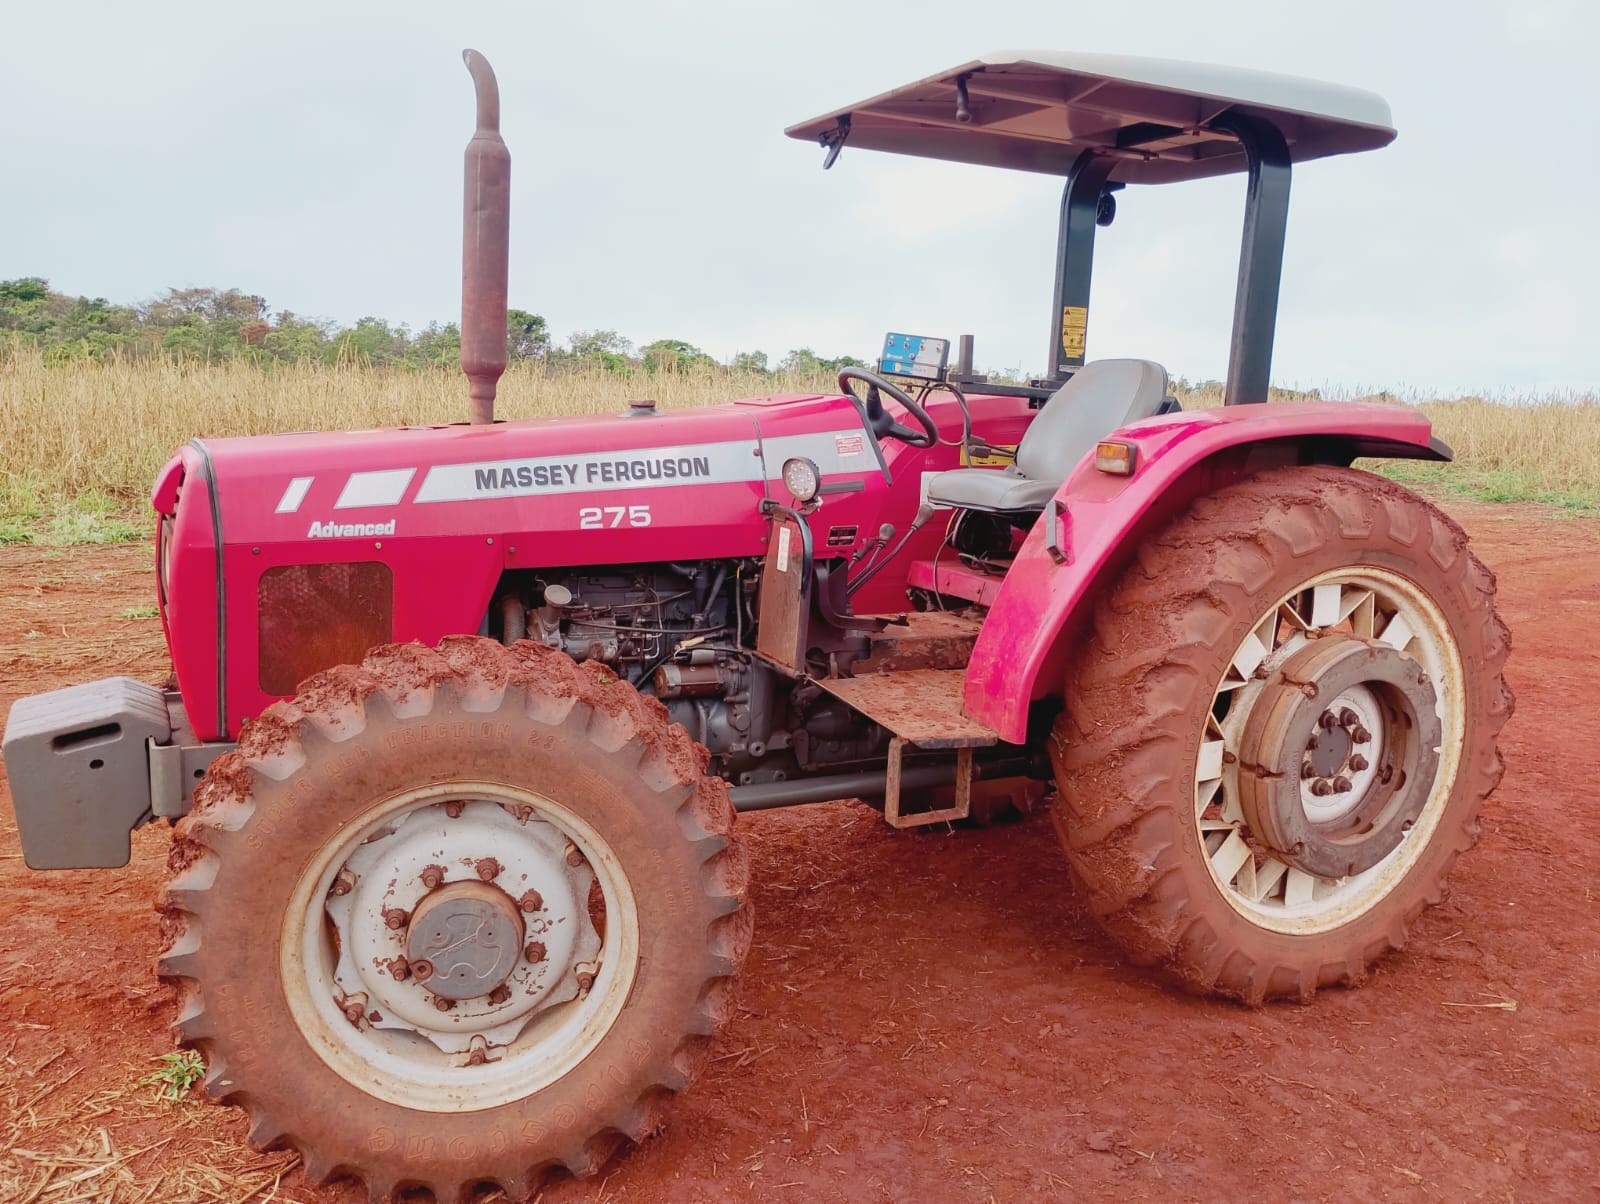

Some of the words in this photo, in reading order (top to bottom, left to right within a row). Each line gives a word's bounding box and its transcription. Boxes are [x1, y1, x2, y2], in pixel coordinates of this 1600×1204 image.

[475, 463, 578, 490] MASSEY
[586, 457, 710, 483] FERGUSON
[307, 518, 396, 538] Advanced
[579, 505, 652, 530] 275
[384, 720, 512, 752] TRACTION
[367, 1037, 651, 1161] Firestone
